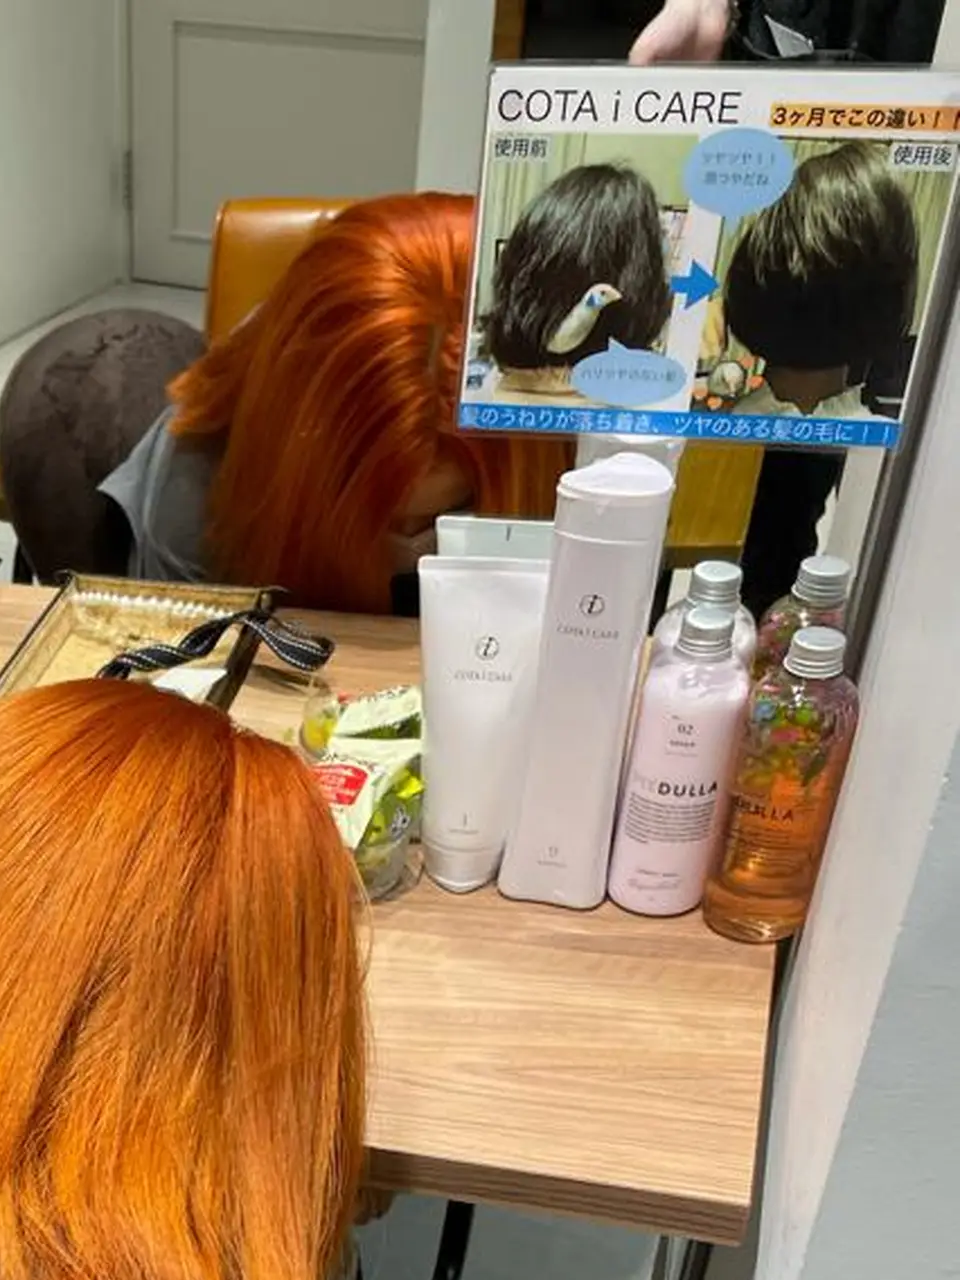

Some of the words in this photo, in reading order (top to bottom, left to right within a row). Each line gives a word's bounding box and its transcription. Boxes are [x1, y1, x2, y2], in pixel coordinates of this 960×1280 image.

[497, 89, 599, 122] COTA
[634, 90, 743, 124] CARE
[494, 138, 547, 158] 使用前
[893, 145, 952, 167] 使用後
